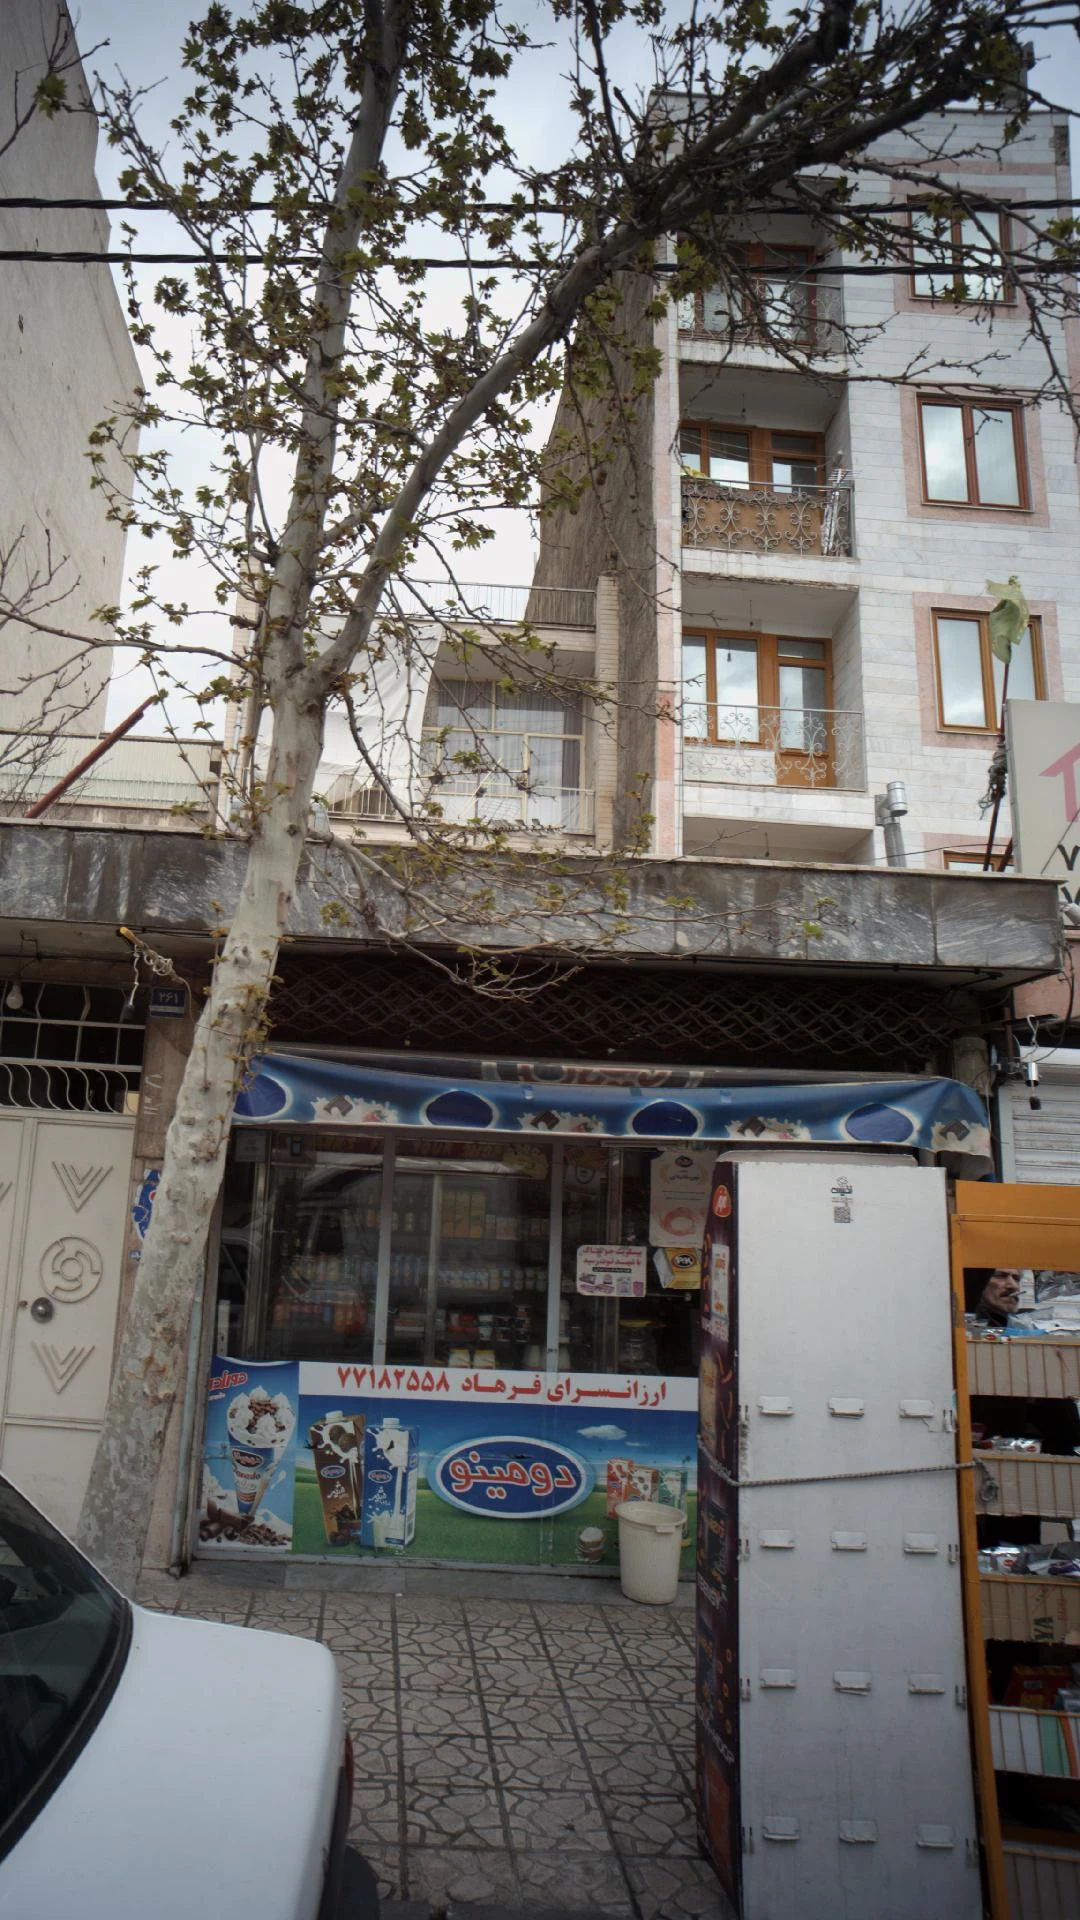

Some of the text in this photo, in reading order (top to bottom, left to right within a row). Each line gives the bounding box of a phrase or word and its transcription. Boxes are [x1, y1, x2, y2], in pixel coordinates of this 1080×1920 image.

[336, 1367, 668, 1407] ارزانسرای فرهاد ۷۷۱۸۲۵۵۸
[450, 1450, 573, 1499] دومینو
